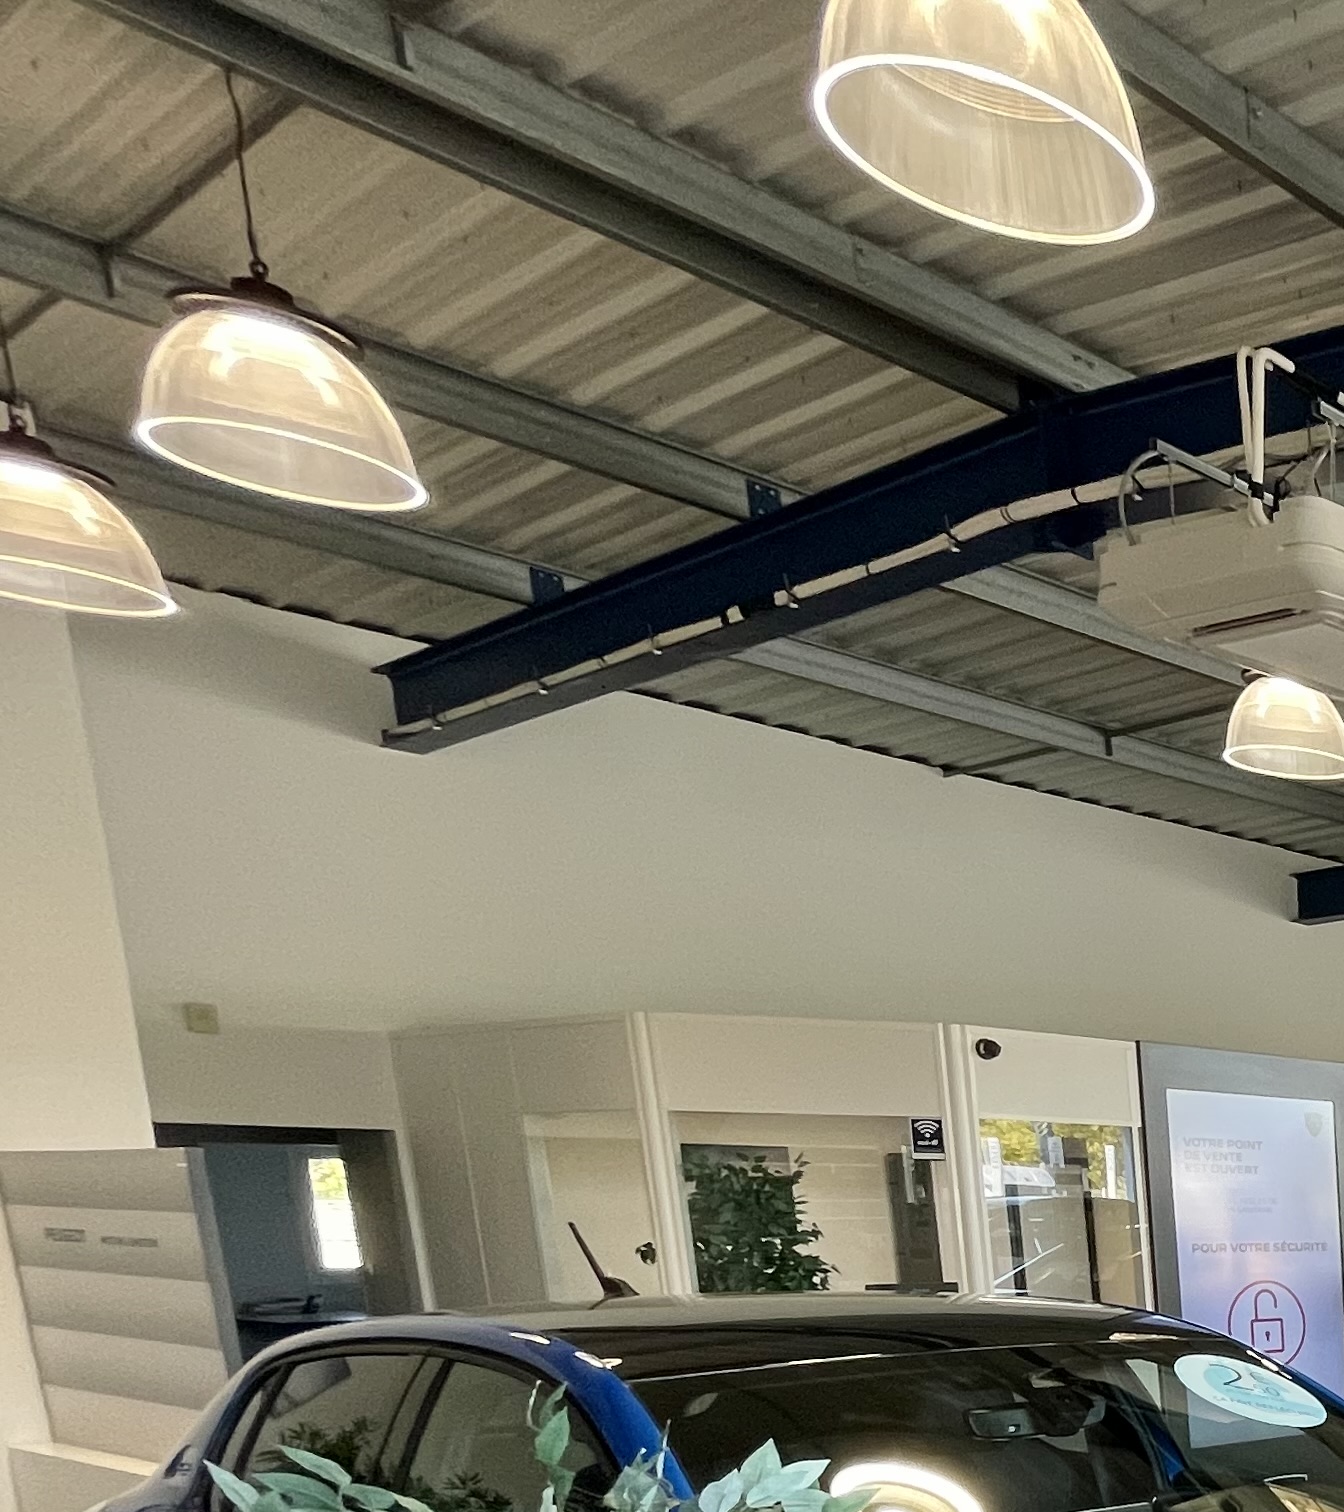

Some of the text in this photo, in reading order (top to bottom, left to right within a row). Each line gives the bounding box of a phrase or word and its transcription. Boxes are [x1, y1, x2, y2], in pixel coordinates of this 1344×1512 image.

[1183, 1137, 1264, 1151] VOTRE POINT
[1184, 1151, 1243, 1162] DE VENTE
[1210, 1164, 1259, 1175] OUVERT
[1191, 1243, 1227, 1254] POUR
[1230, 1242, 1271, 1253] VOTRE
